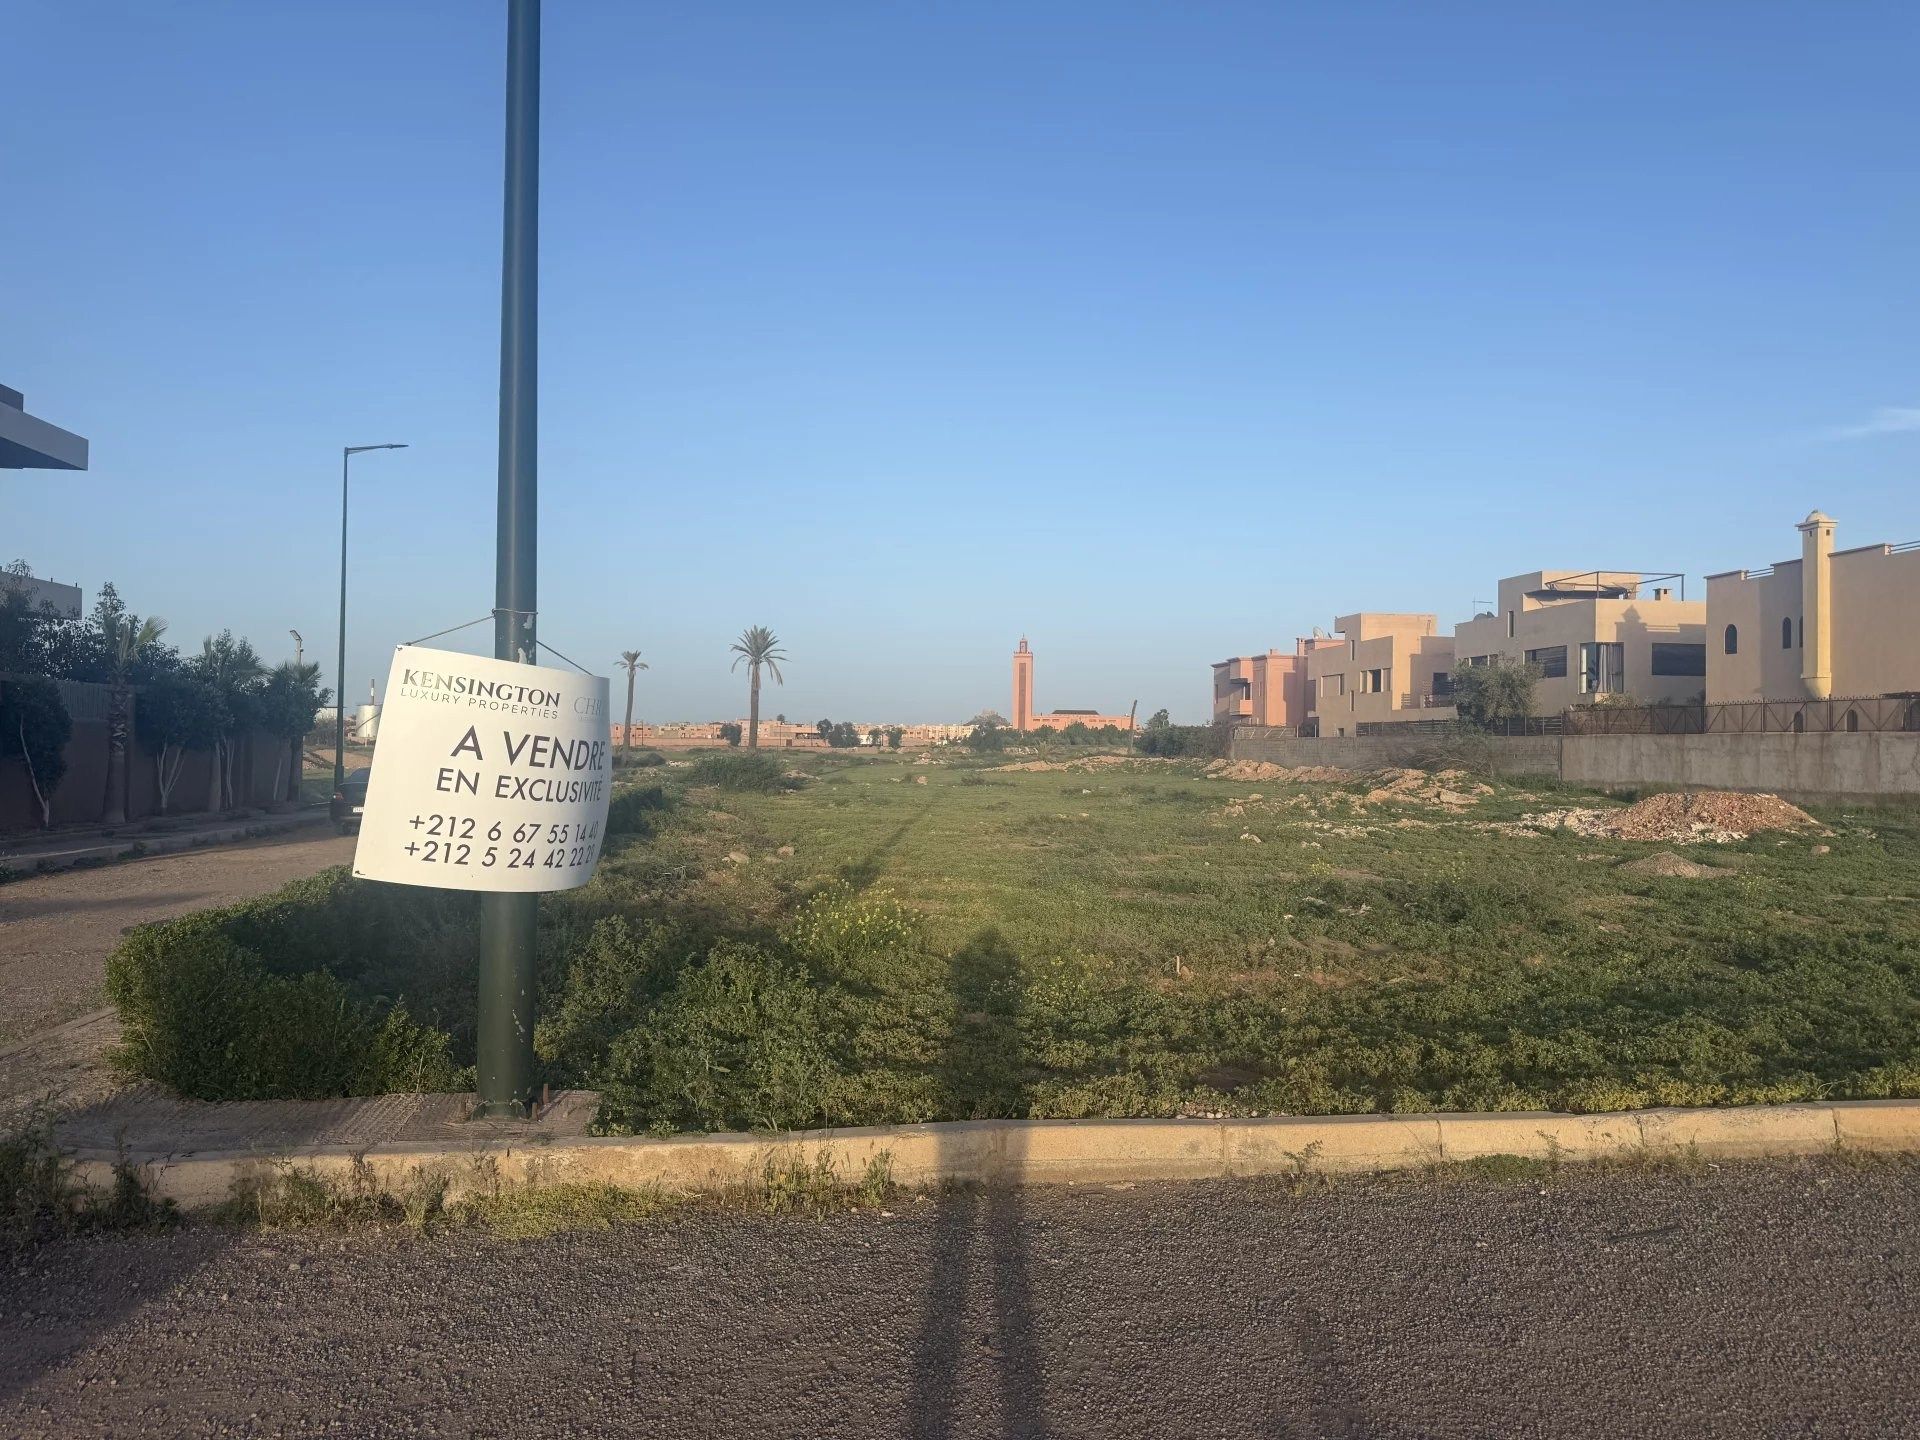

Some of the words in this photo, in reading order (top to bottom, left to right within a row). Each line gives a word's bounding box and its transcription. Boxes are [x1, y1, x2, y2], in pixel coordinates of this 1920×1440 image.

[401, 687, 461, 705] LUXURY
[468, 697, 559, 719] PROPERTIES
[403, 669, 560, 708] KENSINGTON
[450, 725, 484, 761] A
[503, 731, 605, 771] VENDRE
[436, 767, 480, 796] EN
[409, 814, 476, 839] +212
[487, 821, 502, 842] 6
[513, 823, 541, 844] 67
[547, 824, 569, 844] 55
[575, 823, 587, 842] 14
[404, 840, 471, 866] +212
[482, 846, 498, 867] 5
[507, 848, 536, 869] 24
[543, 848, 565, 869] 42
[569, 847, 584, 867] 22
